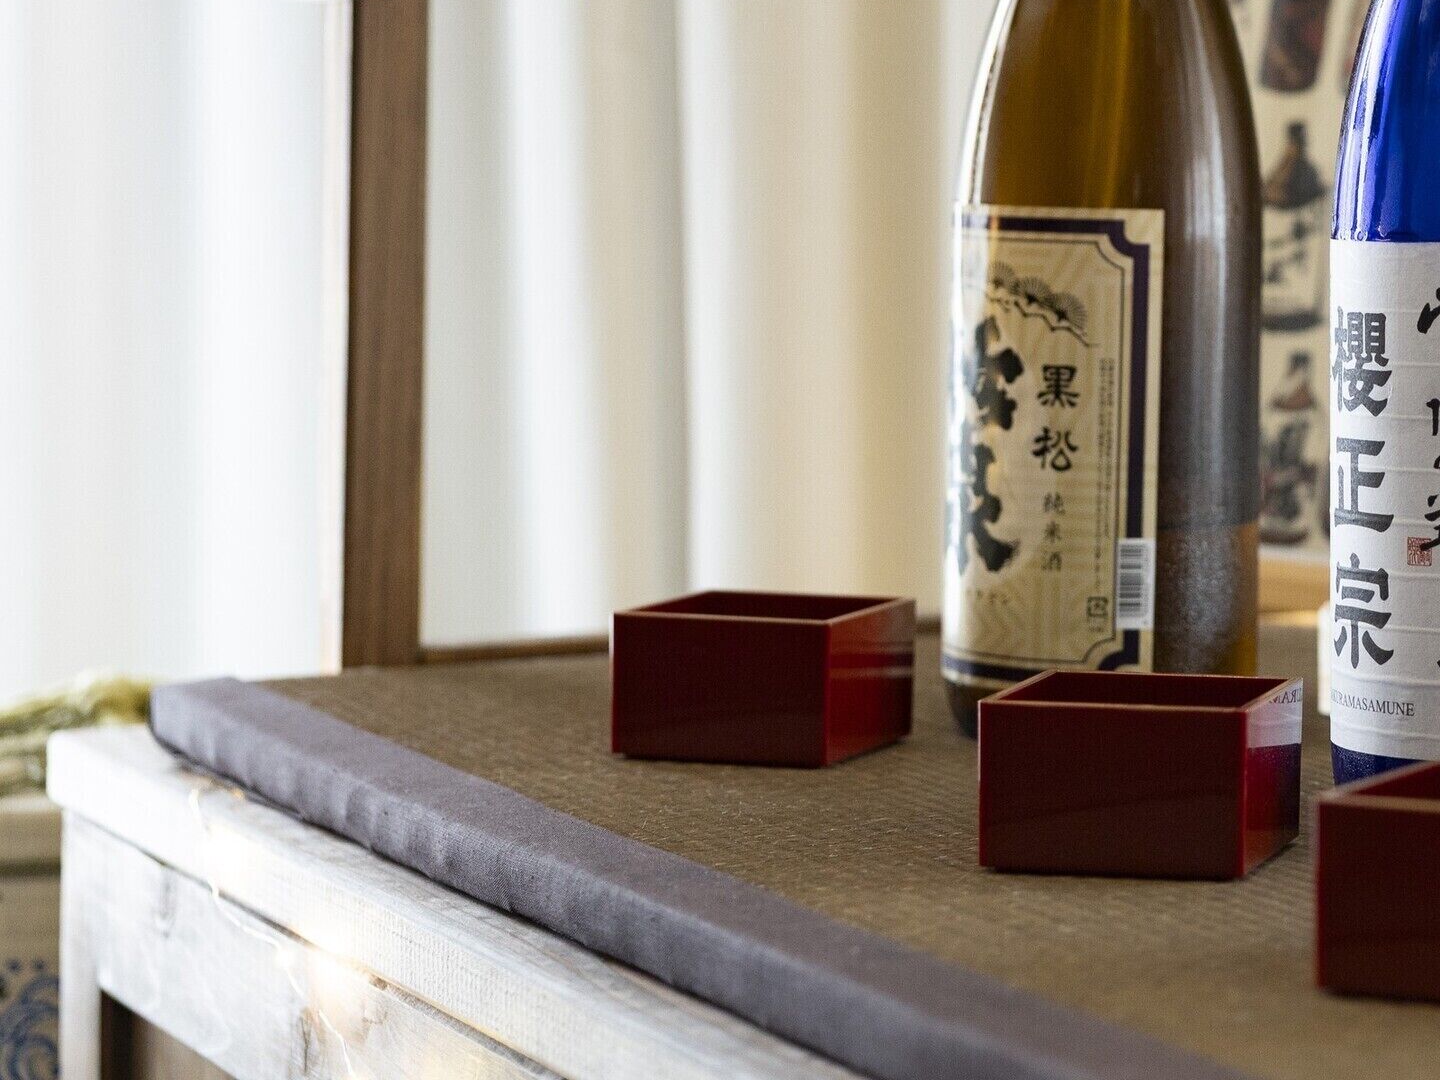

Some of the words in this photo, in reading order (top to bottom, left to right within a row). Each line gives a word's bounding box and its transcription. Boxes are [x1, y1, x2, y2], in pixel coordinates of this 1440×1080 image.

[1033, 363, 1082, 472] 黒松
[1331, 306, 1395, 670] 櫻正宗
